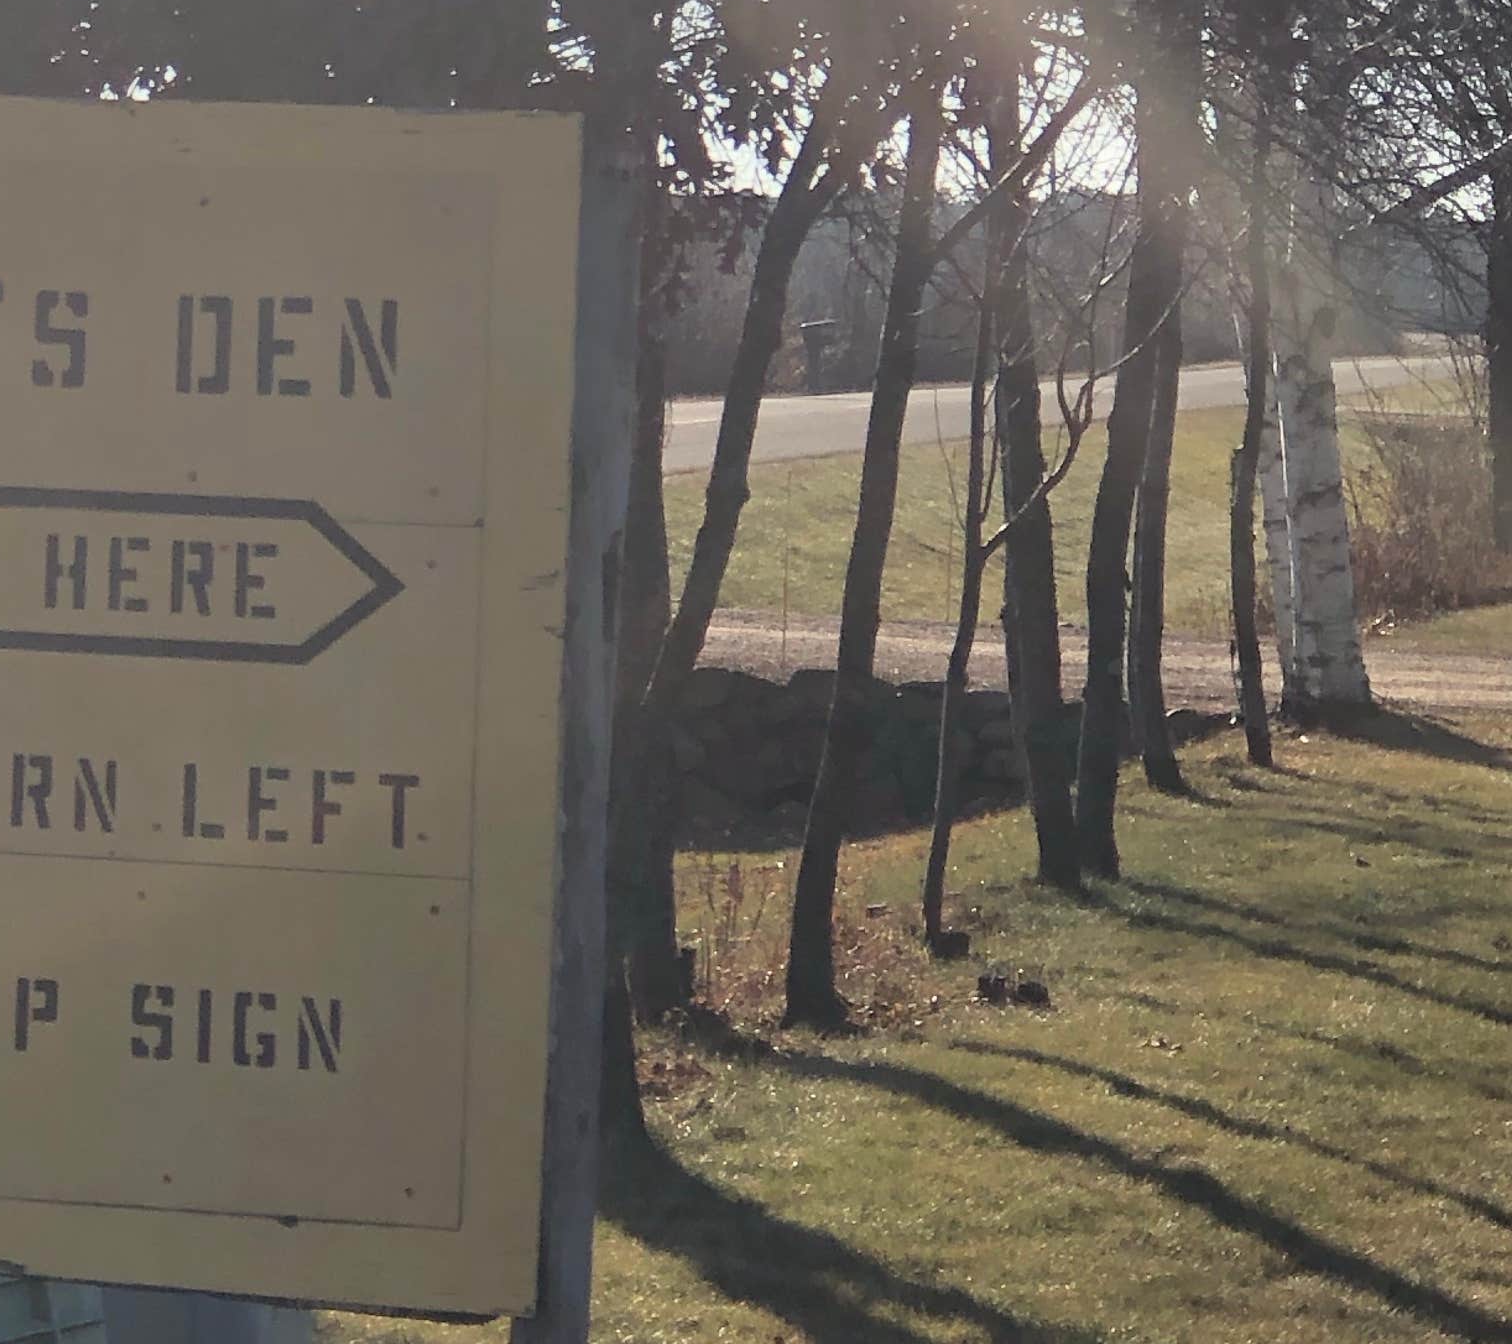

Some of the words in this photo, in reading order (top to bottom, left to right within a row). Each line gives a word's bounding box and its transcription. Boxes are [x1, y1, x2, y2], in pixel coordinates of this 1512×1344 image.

[176, 295, 400, 400] DEN
[44, 533, 280, 620] HERE
[181, 762, 420, 849] LEFT
[130, 983, 343, 1073] SIGN
